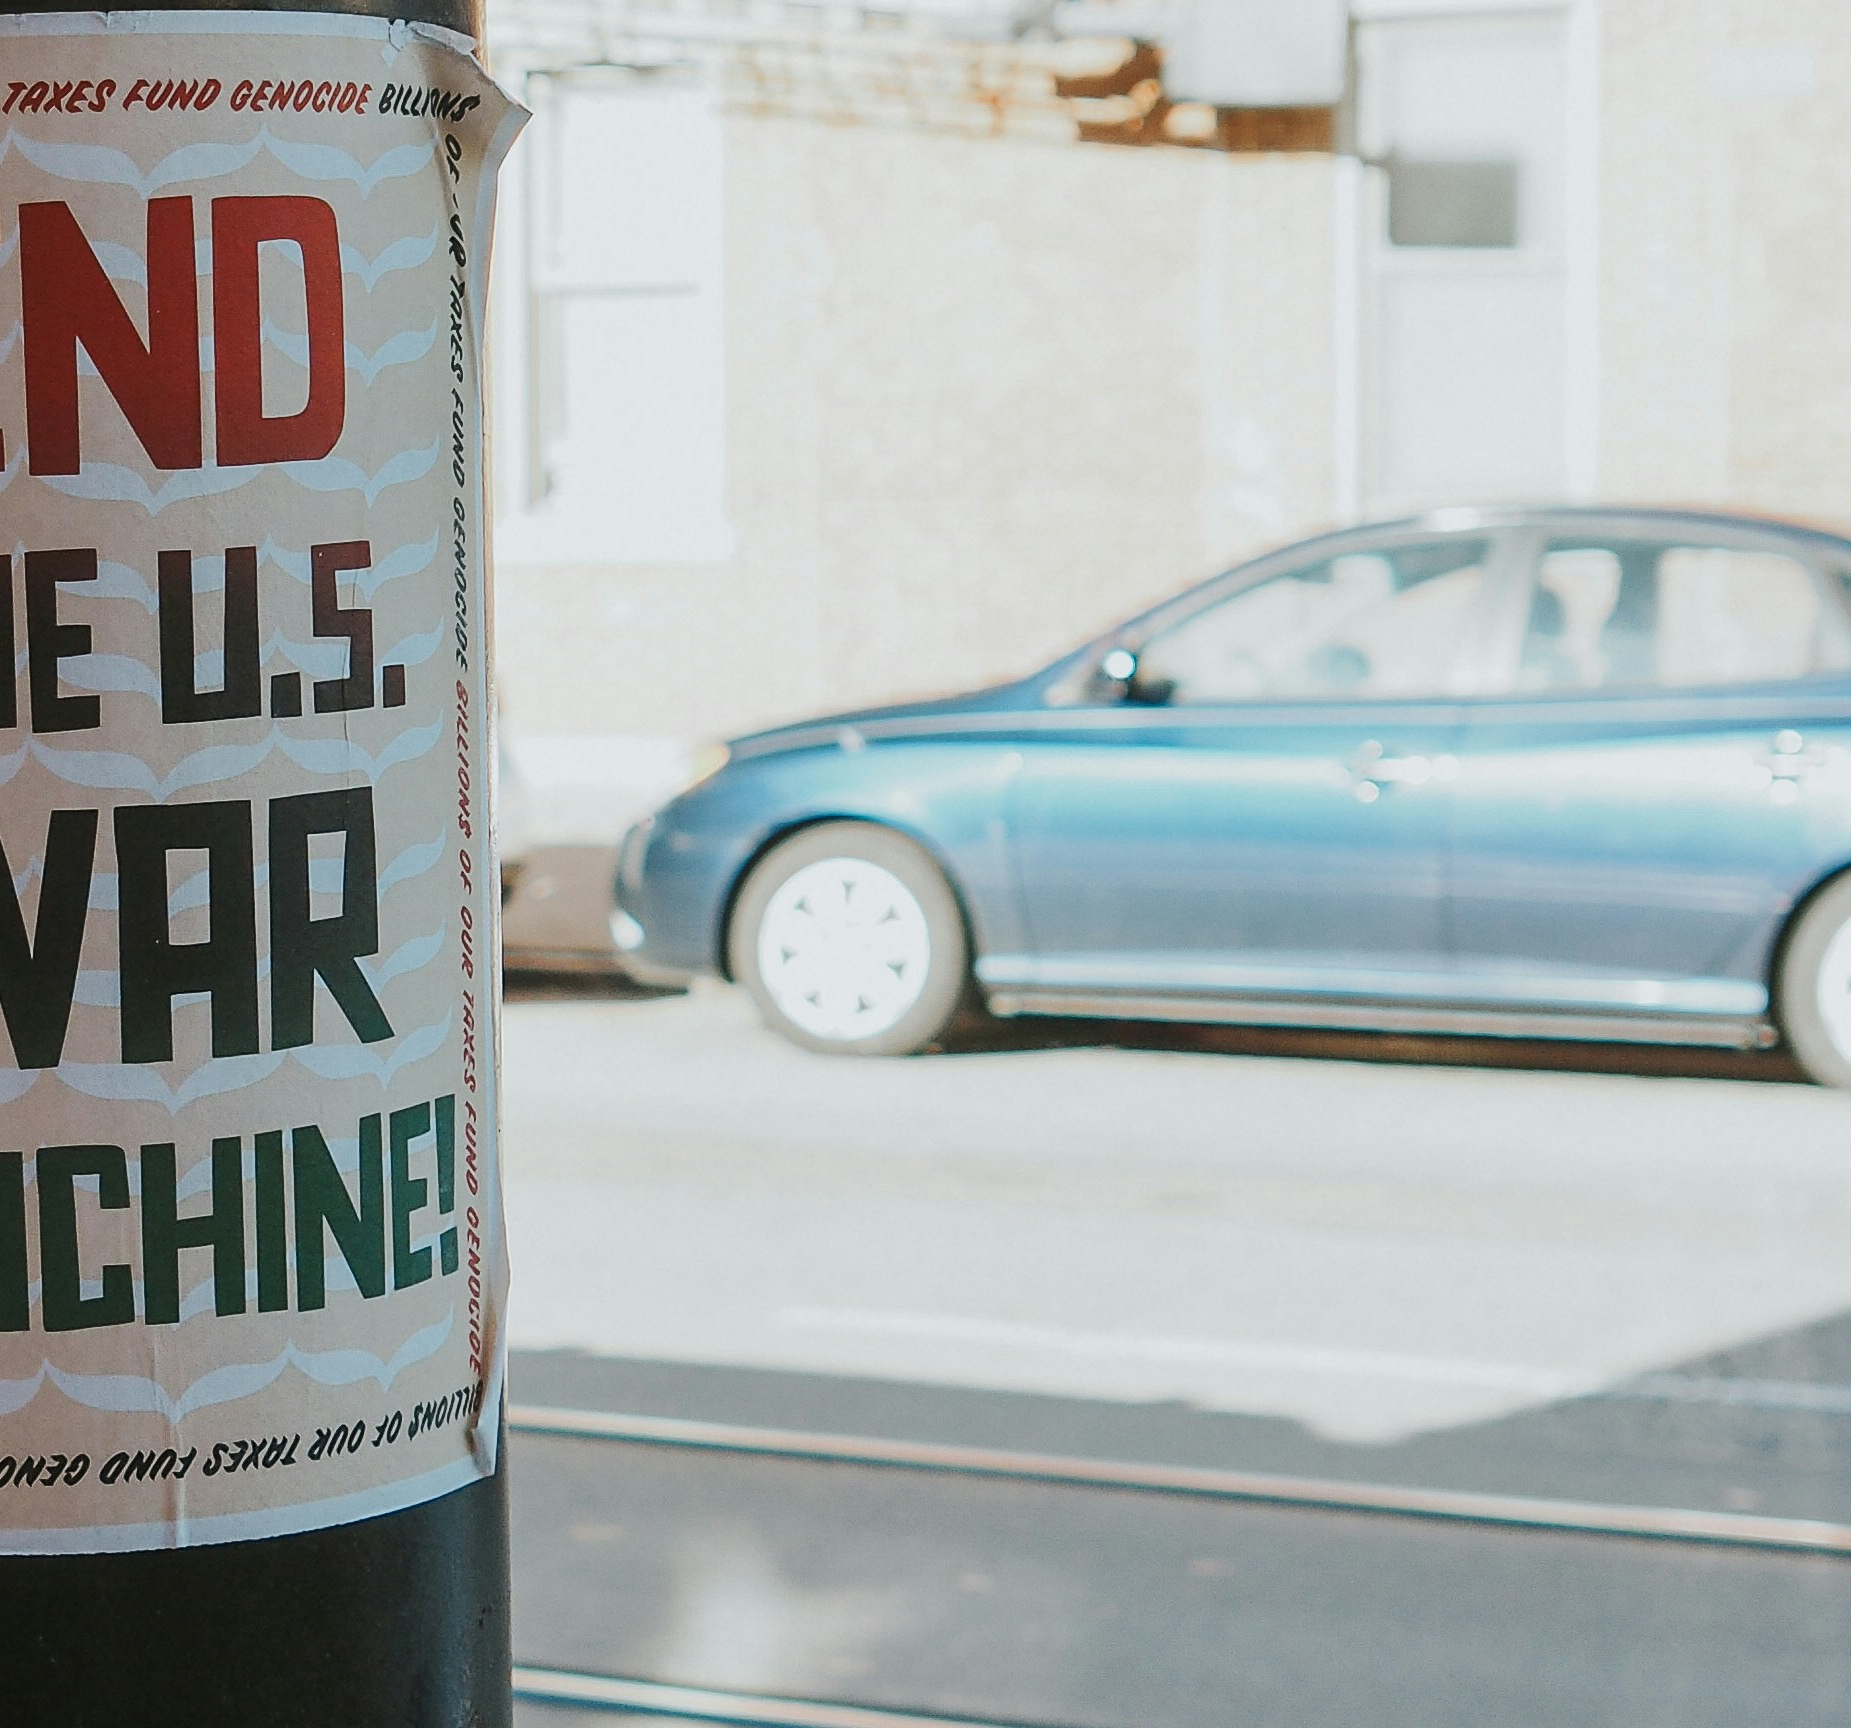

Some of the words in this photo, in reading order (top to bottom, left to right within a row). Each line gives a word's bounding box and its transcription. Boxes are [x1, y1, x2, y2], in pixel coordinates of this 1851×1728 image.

[1, 79, 116, 115] TAXES
[122, 77, 223, 113] FUND
[230, 79, 373, 115] GENOCIDE
[449, 275, 465, 384] TAXES
[452, 388, 466, 489] FUND
[453, 497, 469, 673] GENOCIDE
[157, 540, 406, 726] U.S.
[459, 848, 473, 895] OF
[460, 905, 474, 980] OUR
[463, 989, 477, 1094] TAXES
[464, 1101, 479, 1196] FUND
[466, 1205, 483, 1377] GENOCIDE
[99, 1446, 197, 1485] FUND
[203, 1433, 301, 1477] TAXES
[307, 1419, 367, 1462] OUR
[371, 1410, 403, 1448] OF
